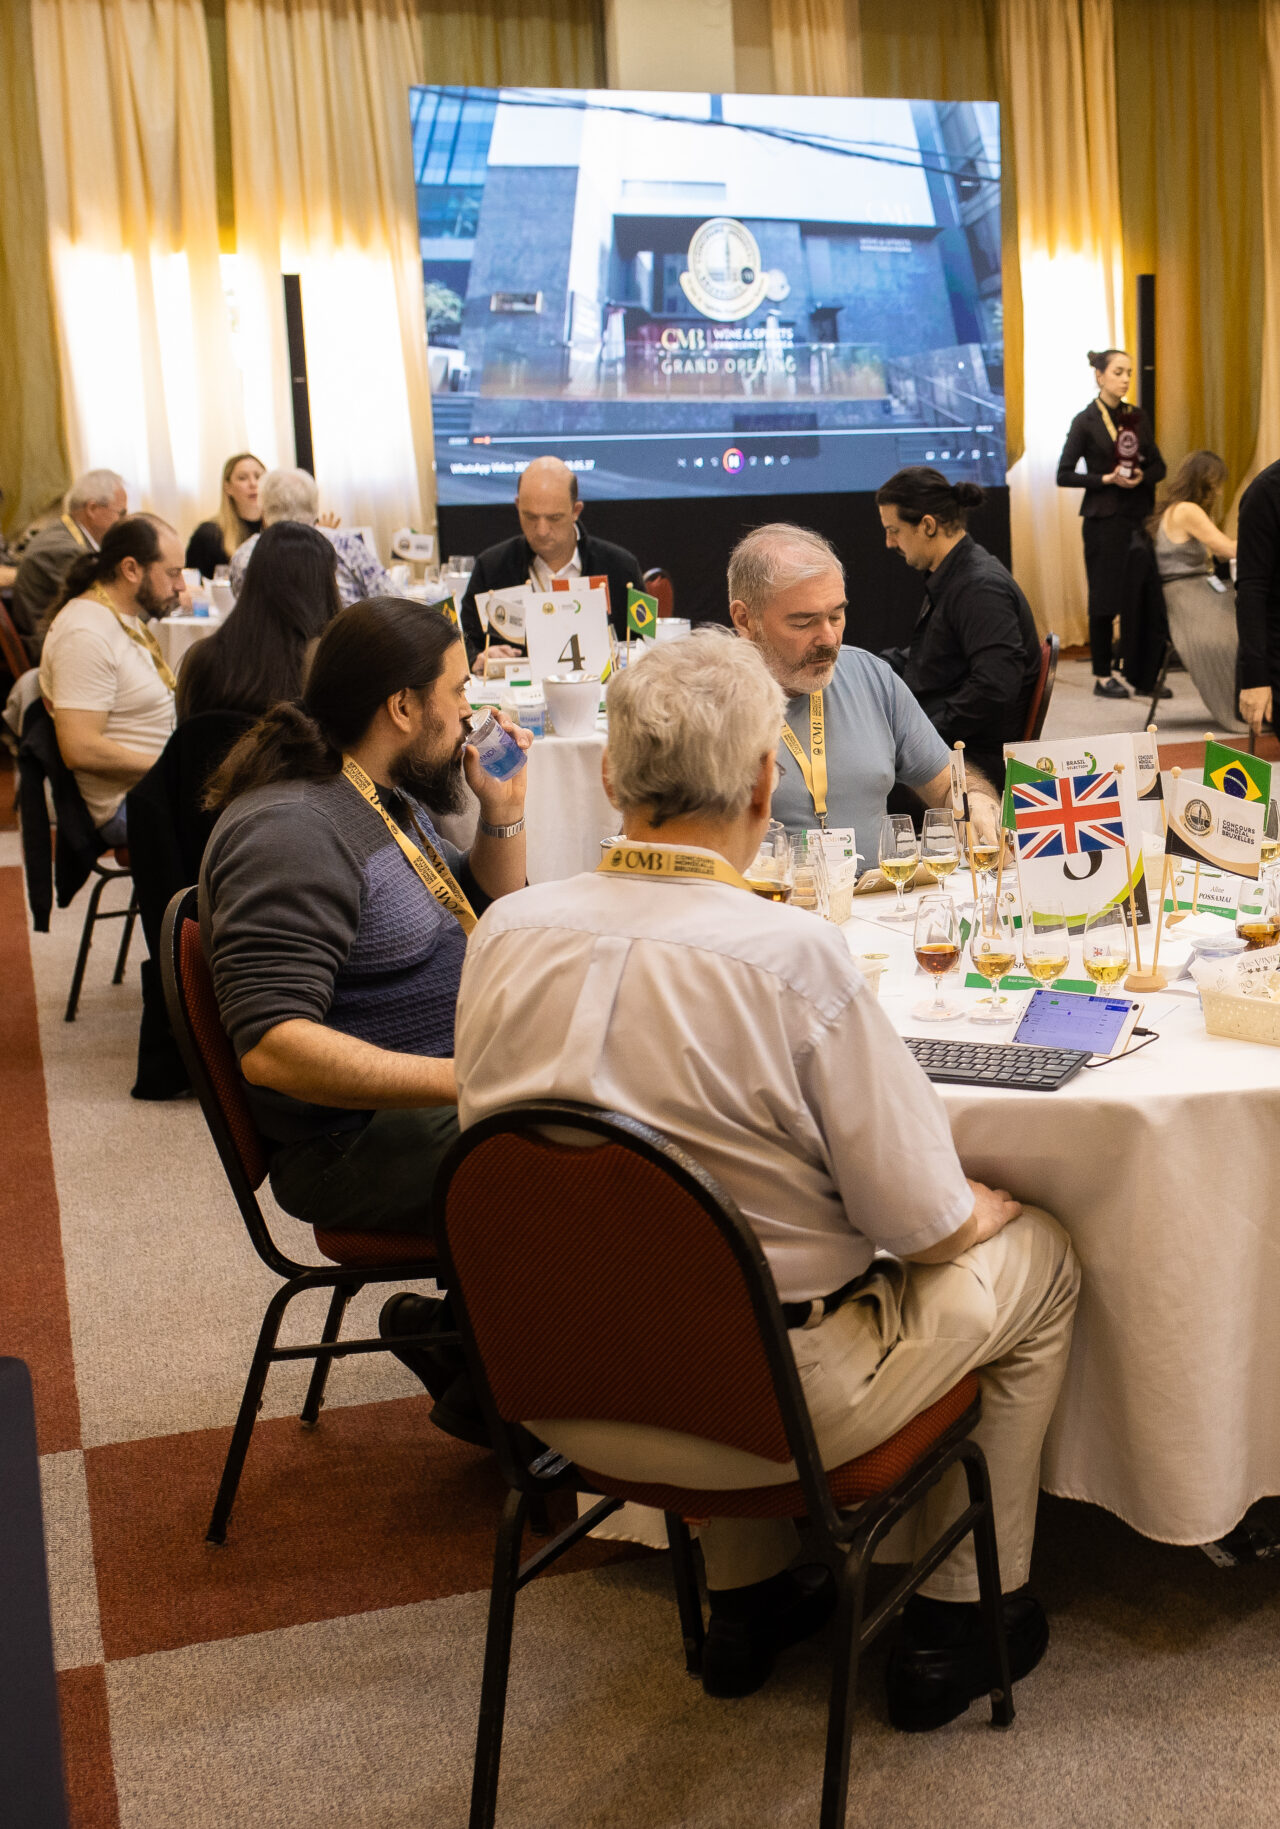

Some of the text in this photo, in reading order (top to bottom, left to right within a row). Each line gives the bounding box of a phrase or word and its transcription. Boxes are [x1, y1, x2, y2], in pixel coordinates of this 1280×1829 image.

[661, 328, 706, 350] CMB
[661, 357, 719, 375] GRAND
[450, 462, 491, 476] WhatsApp
[491, 461, 514, 473] Video
[558, 633, 586, 672] 4
[812, 722, 823, 745] CMB
[1222, 819, 1256, 835] CONCOURS
[1222, 825, 1249, 837] MONDIAL
[1221, 829, 1255, 845] BRUXELLES
[426, 845, 445, 874] CMB
[625, 850, 663, 871] CMB
[434, 886, 458, 910] CMB
[1198, 892, 1232, 903] POSSAMAI
